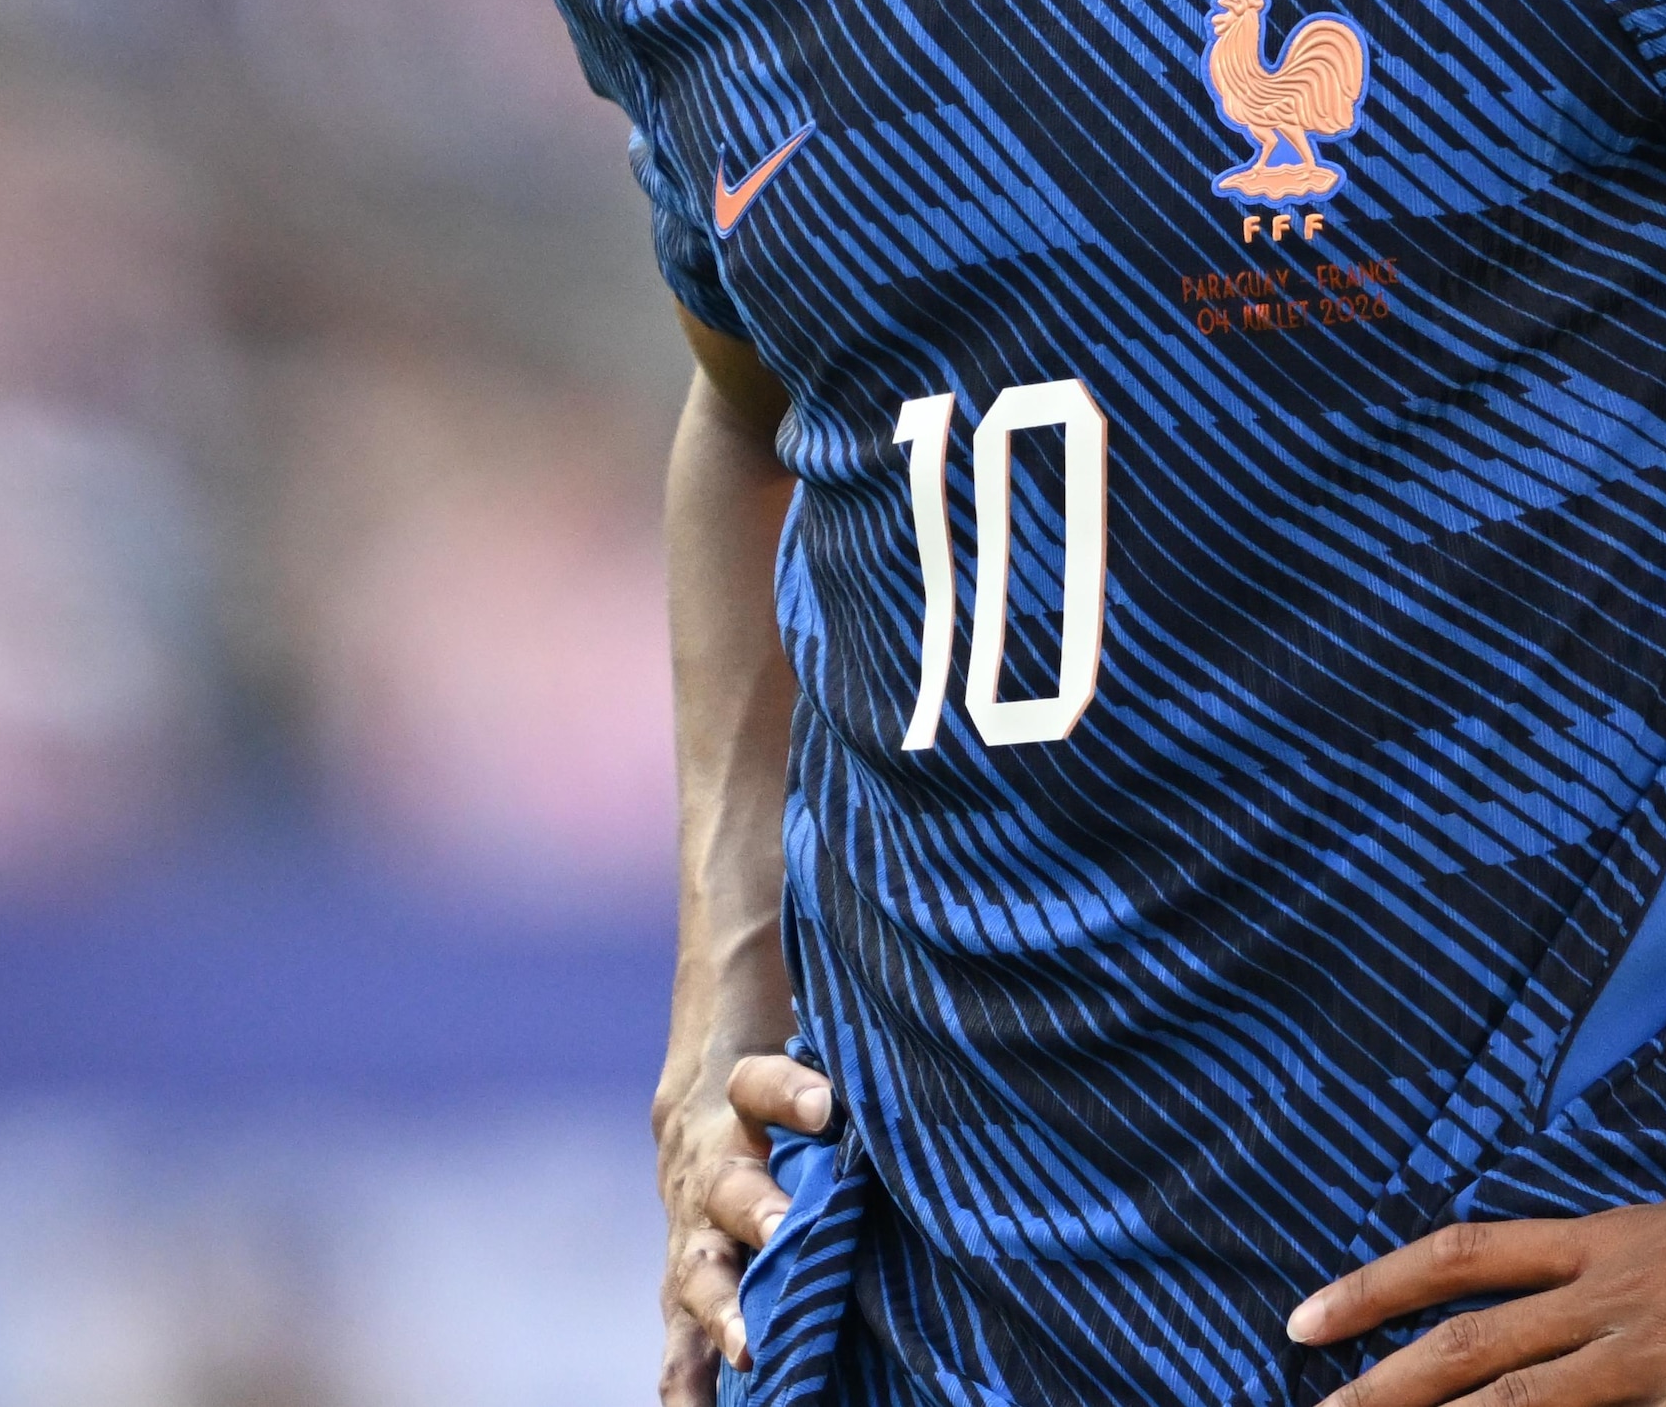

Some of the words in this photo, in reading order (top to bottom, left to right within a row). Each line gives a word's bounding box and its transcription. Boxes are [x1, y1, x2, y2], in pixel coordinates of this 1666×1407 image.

[1181, 268, 1290, 303] PARAGUAY
[1315, 257, 1399, 291] FRANCE
[1196, 307, 1231, 335] 04
[1318, 290, 1389, 327] 2026
[892, 378, 1108, 751] 10
